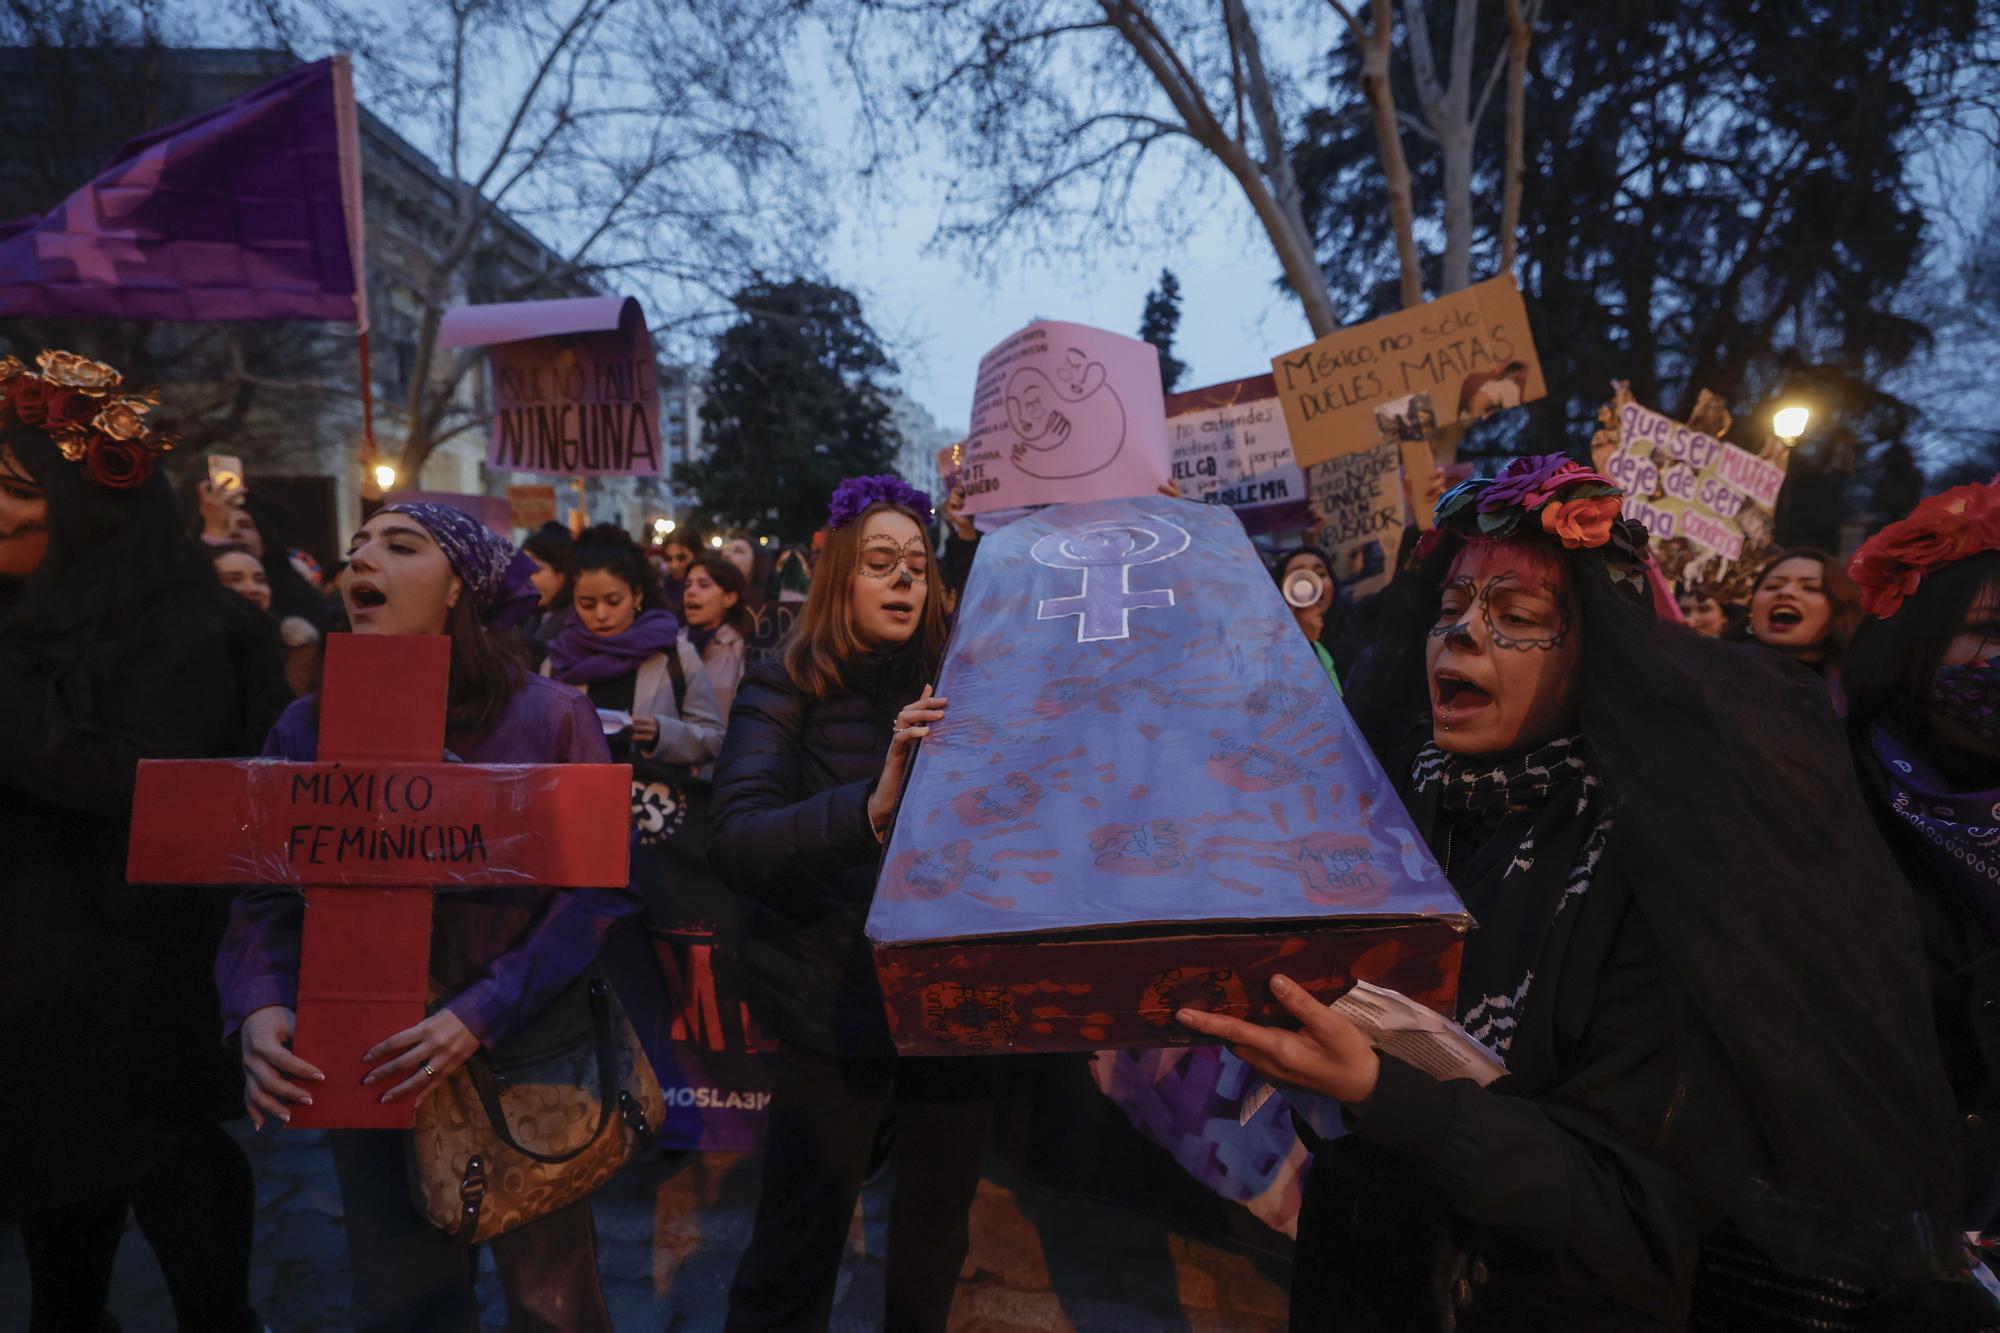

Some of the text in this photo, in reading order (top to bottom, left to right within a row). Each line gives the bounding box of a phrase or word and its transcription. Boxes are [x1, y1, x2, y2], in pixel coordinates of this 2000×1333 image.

[1380, 332, 1413, 353] no
[1400, 325, 1515, 391] MATAS
[497, 402, 658, 472] NINGUNA
[1621, 405, 1670, 445] que
[1672, 428, 1720, 467] ser
[1608, 448, 1744, 516] deje de ser
[290, 762, 434, 813] MÉXICO
[288, 817, 488, 865] FEMINICIDA
